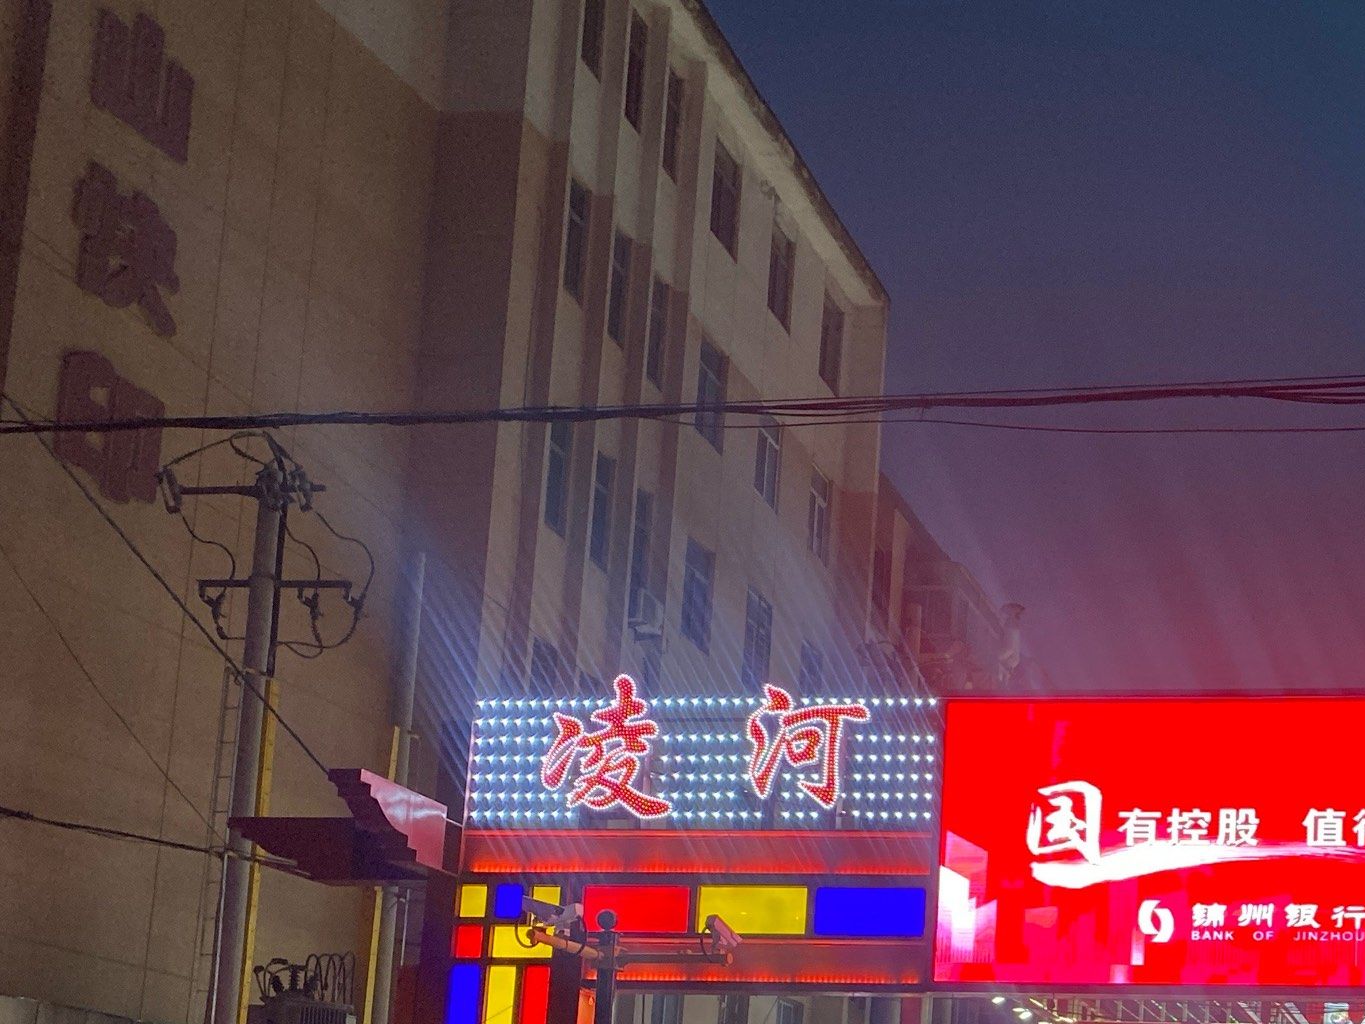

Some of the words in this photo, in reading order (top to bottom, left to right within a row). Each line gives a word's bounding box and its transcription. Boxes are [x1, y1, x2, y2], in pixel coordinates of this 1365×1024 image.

[541, 673, 871, 819] 凌河
[1026, 780, 1260, 866] 国有控股
[1191, 930, 1234, 941] BANK
[1253, 930, 1274, 941] OF
[1293, 930, 1365, 942] JINZHOU
